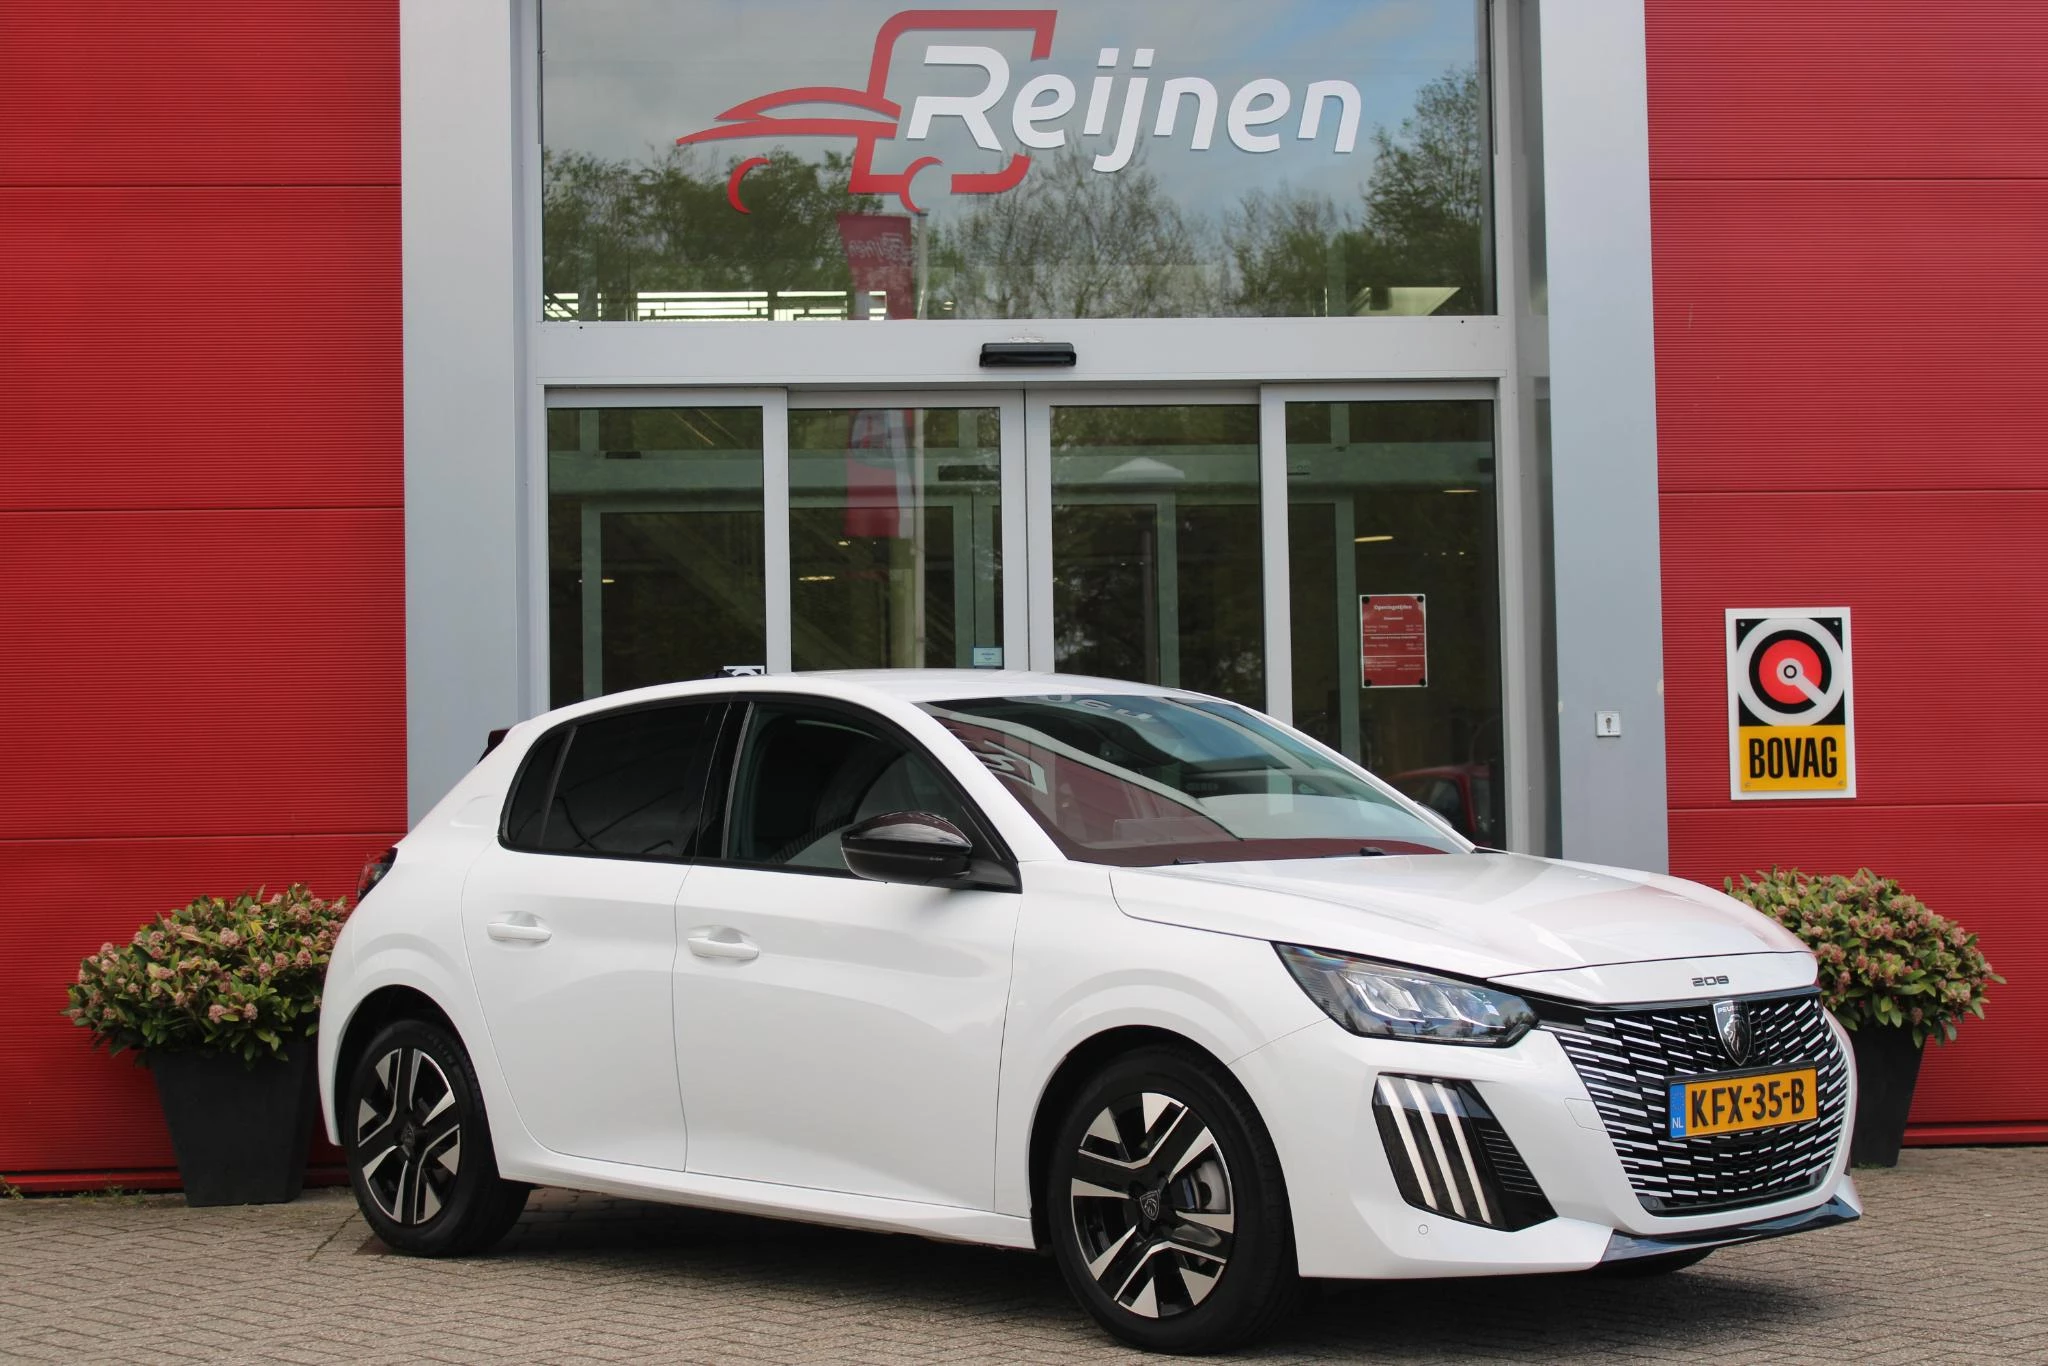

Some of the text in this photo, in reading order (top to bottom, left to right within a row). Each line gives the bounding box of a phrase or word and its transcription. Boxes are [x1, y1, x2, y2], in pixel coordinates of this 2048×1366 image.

[907, 46, 1361, 172] Reijnen
[1749, 737, 1837, 778] BOVAG
[1691, 975, 1729, 987] 208
[1672, 1078, 1805, 1129] NL KFX-35-B
